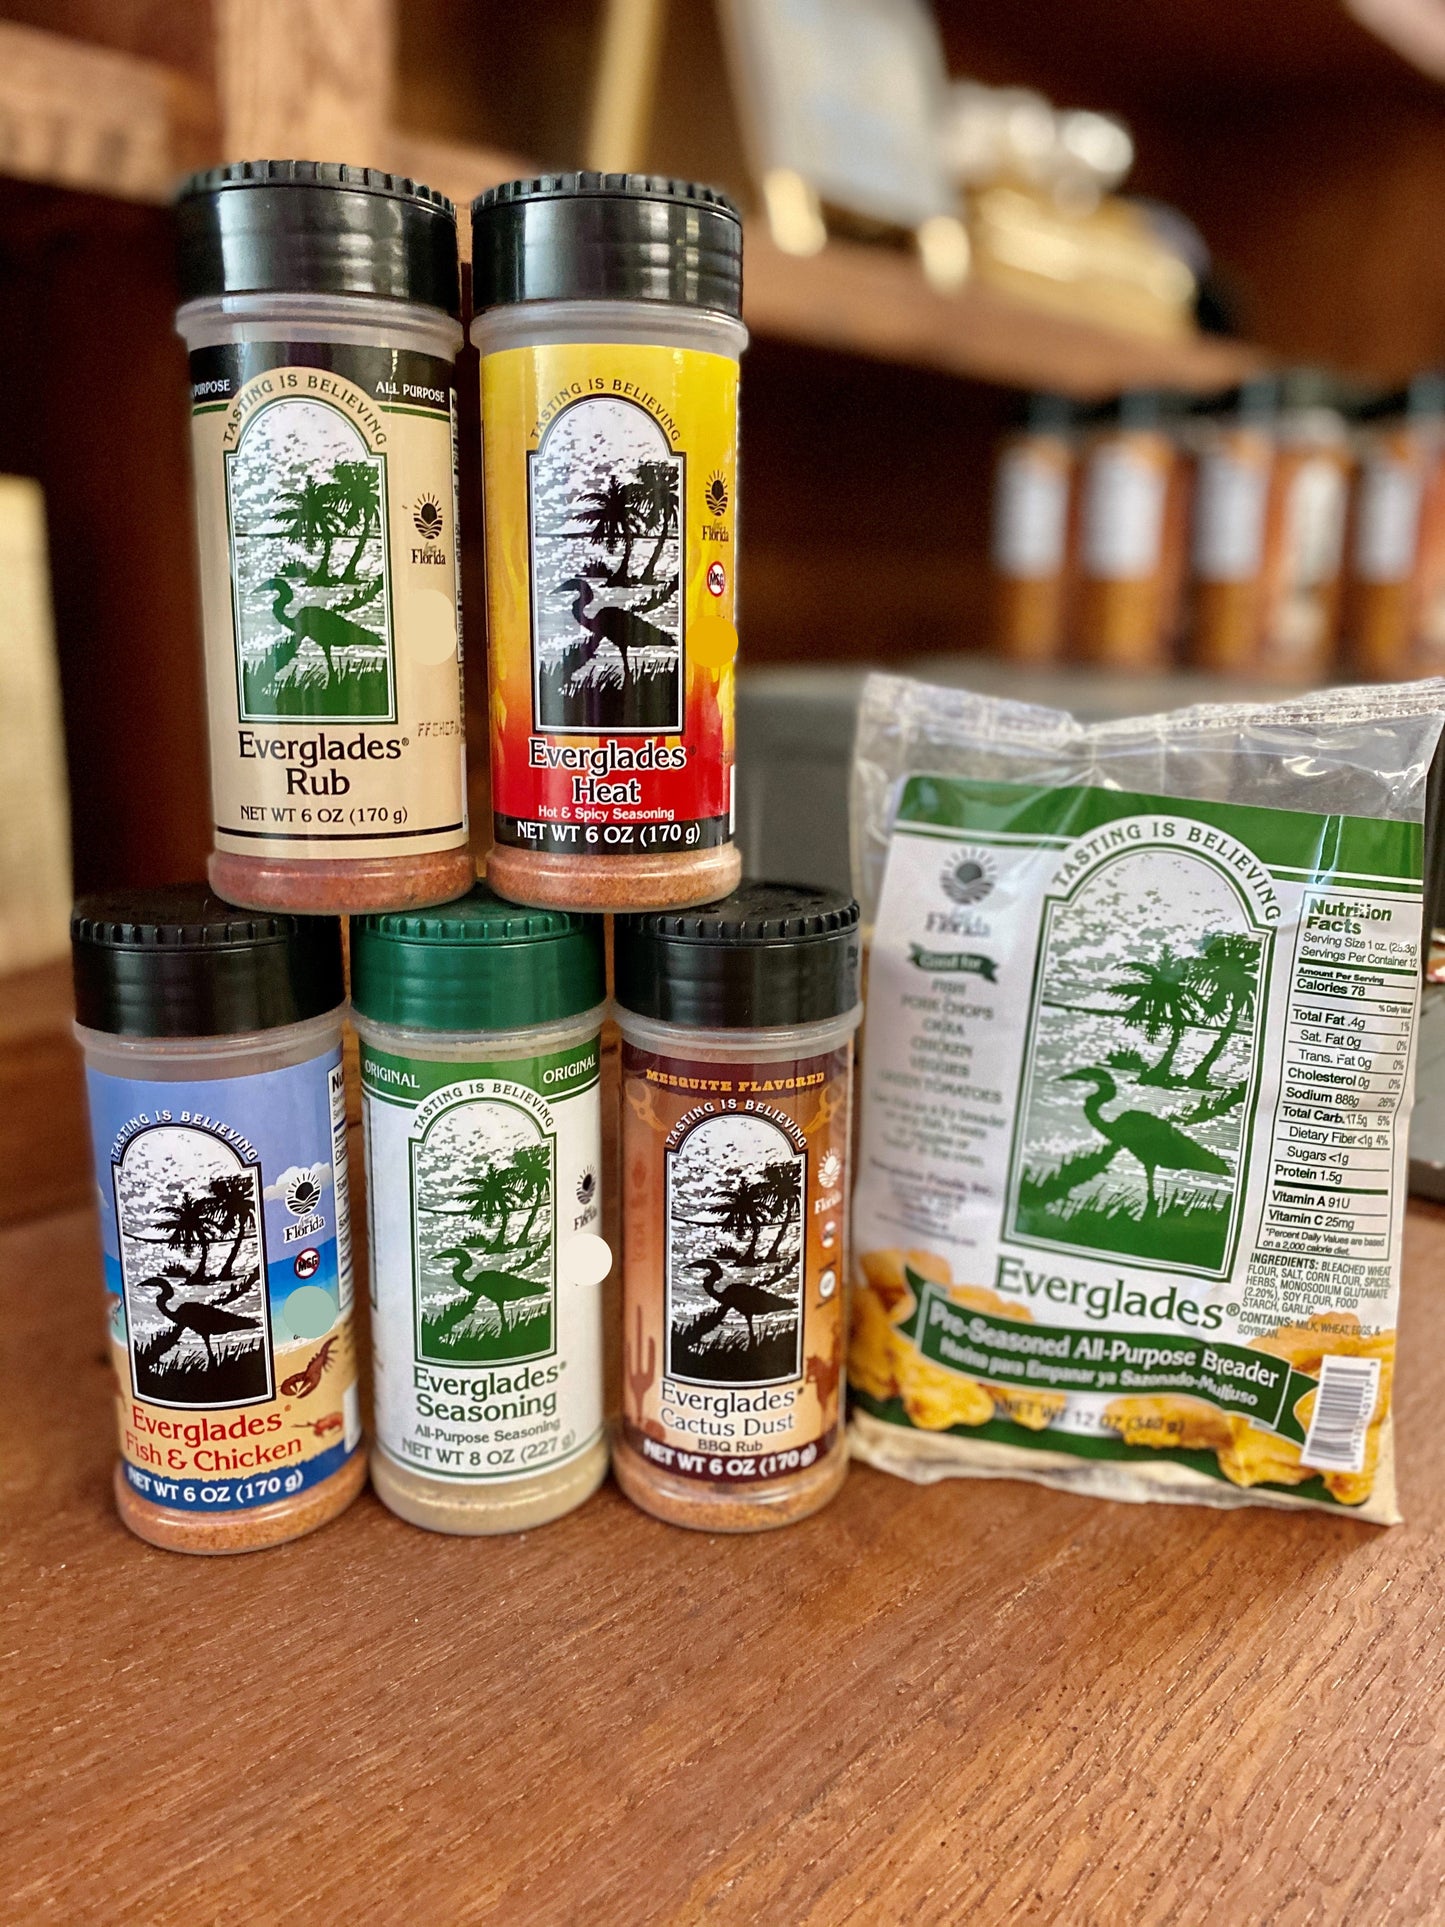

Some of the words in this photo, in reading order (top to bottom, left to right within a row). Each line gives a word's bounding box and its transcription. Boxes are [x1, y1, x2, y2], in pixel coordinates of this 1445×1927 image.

[375, 380, 400, 394] ALL
[403, 386, 445, 403] PURPOSE
[223, 382, 272, 444] TASTING
[280, 374, 298, 389] IS
[307, 375, 387, 446] BELIEVING
[530, 382, 582, 440] TASTING
[589, 377, 605, 390] IS
[612, 379, 681, 442] BELIEVING
[702, 525, 729, 542] Florida
[411, 548, 446, 565] Florida
[529, 737, 686, 777] Everglades
[285, 768, 351, 796] Rub
[572, 776, 641, 804] Heat
[241, 806, 266, 821] NET
[272, 808, 296, 822] WT
[301, 808, 313, 823] 6
[317, 808, 343, 824] OZ
[349, 807, 388, 827] (170
[392, 806, 409, 824] g)
[539, 805, 557, 818] Hot
[561, 806, 572, 818] &
[575, 808, 608, 822] Spicy
[612, 807, 675, 821] Seasoning
[517, 821, 547, 840] NET
[551, 824, 580, 843] WT
[586, 826, 599, 844] 6
[604, 826, 635, 844] OZ
[640, 824, 681, 847] (170
[685, 823, 701, 844] g)
[1053, 824, 1142, 888] TASTING
[1153, 821, 1175, 837] IS
[1187, 826, 1281, 921] BELIEVING
[1309, 898, 1393, 922] Nutrition
[1306, 916, 1362, 935] Facts
[1303, 932, 1342, 948] Serving
[1344, 937, 1366, 949] Size
[1375, 942, 1387, 951] oz.
[1301, 945, 1346, 961] Servings
[1348, 952, 1366, 963] Per
[1368, 953, 1407, 967] Container
[1409, 957, 1417, 968] 12
[1296, 977, 1348, 995] Calories
[1351, 985, 1366, 997] 78
[1298, 967, 1333, 978] Amount
[1336, 971, 1352, 981] Per
[1353, 974, 1384, 985] Serving
[1293, 1009, 1322, 1022] Total
[1325, 1013, 1345, 1026] Fat
[1347, 1018, 1366, 1030] .4g
[1300, 1029, 1322, 1043] Sat.
[1325, 1033, 1345, 1046] Fat
[1346, 1036, 1362, 1049] 0g
[543, 1054, 596, 1084] ORIGINAL
[1299, 1048, 1333, 1063] Trans.
[1336, 1053, 1355, 1066] Fat
[1357, 1057, 1372, 1070] 0g
[365, 1060, 420, 1088] ORIGINAL
[646, 1069, 732, 1092] MESQUITE
[738, 1072, 825, 1092] FLAVORED
[1288, 1067, 1357, 1086] Cholesterol
[1358, 1076, 1370, 1089] 0g
[413, 1088, 463, 1130] TASTING
[469, 1083, 485, 1094] IS
[492, 1083, 554, 1128] BELIEVING
[1285, 1087, 1332, 1103] Sodium
[665, 1103, 714, 1147] TASTING
[721, 1098, 737, 1110] IS
[745, 1099, 807, 1149] BELIEVING
[1282, 1105, 1311, 1119] Total
[1314, 1110, 1345, 1124] Carb.
[1377, 1115, 1390, 1126] 5%
[110, 1113, 150, 1162] TASTING
[154, 1109, 172, 1122] IS
[180, 1110, 259, 1163] BELIEVING
[1289, 1126, 1329, 1143] Dietary
[1332, 1132, 1356, 1144] Fiber
[1357, 1135, 1373, 1147] <1g
[1376, 1135, 1389, 1146] 4%
[1287, 1145, 1327, 1161] Sugars
[1328, 1153, 1349, 1166] <1g
[1275, 1164, 1317, 1179] Protein
[1320, 1171, 1343, 1184] 1.5g
[1272, 1190, 1315, 1205] Vitamin
[1316, 1196, 1326, 1206] A
[285, 1217, 325, 1242] Florida
[1269, 1209, 1312, 1225] Vitamin
[1314, 1215, 1323, 1225] C
[1325, 1217, 1355, 1231] 25mg
[1283, 1241, 1305, 1251] 2,000
[1301, 1230, 1321, 1243] Daily
[1323, 1233, 1349, 1244] Values
[1247, 1265, 1278, 1278] FLOUR,
[1281, 1268, 1303, 1281] SALT,
[1306, 1271, 1330, 1283] CORN
[1332, 1275, 1363, 1287] FLOUR,
[1250, 1253, 1319, 1270] INGREDIENTS:
[1321, 1261, 1366, 1275] BLEACHED
[1367, 1265, 1392, 1276] WHEAT
[1246, 1276, 1278, 1289] HERBS,
[1280, 1279, 1341, 1295] MONOSODIUM
[1343, 1286, 1388, 1299] GLUTAMATE
[1242, 1297, 1280, 1312] STARCH,
[1282, 1291, 1301, 1302] SOY
[1303, 1294, 1333, 1308] FLOUR,
[1335, 1298, 1358, 1309] FOOD
[1240, 1311, 1293, 1328] CONTAINS:
[929, 1300, 1072, 1359] Pre-Seasoned
[1073, 1335, 1196, 1371] All-Purpose
[1201, 1349, 1280, 1388] Breader
[413, 1365, 559, 1403] Everglades
[416, 1392, 557, 1423] Seasoning
[661, 1381, 795, 1418] Everglades
[131, 1405, 283, 1449] Everglades
[415, 1424, 489, 1445] All-Purpose
[494, 1419, 560, 1442] Seasoning
[661, 1407, 735, 1437] Cactus
[744, 1414, 795, 1436] Dust
[125, 1430, 162, 1467] Fish
[167, 1451, 188, 1471] &
[193, 1437, 302, 1472] Chicken
[402, 1437, 432, 1460] NET
[437, 1449, 464, 1465] WT
[469, 1451, 481, 1466] 8
[487, 1450, 515, 1465] OZ
[521, 1436, 558, 1464] (227
[561, 1429, 576, 1451] g)
[698, 1439, 731, 1452] BBQ
[736, 1440, 763, 1452] Rub
[643, 1439, 675, 1466] NET
[677, 1451, 706, 1473] WT
[709, 1458, 724, 1476] 6
[726, 1458, 757, 1476] OZ
[760, 1449, 799, 1477] (170
[128, 1466, 151, 1492] NET
[153, 1481, 179, 1500] WT
[183, 1486, 196, 1502] 6
[200, 1486, 231, 1503] OZ
[235, 1478, 280, 1504] (170
[285, 1469, 304, 1493] g)
